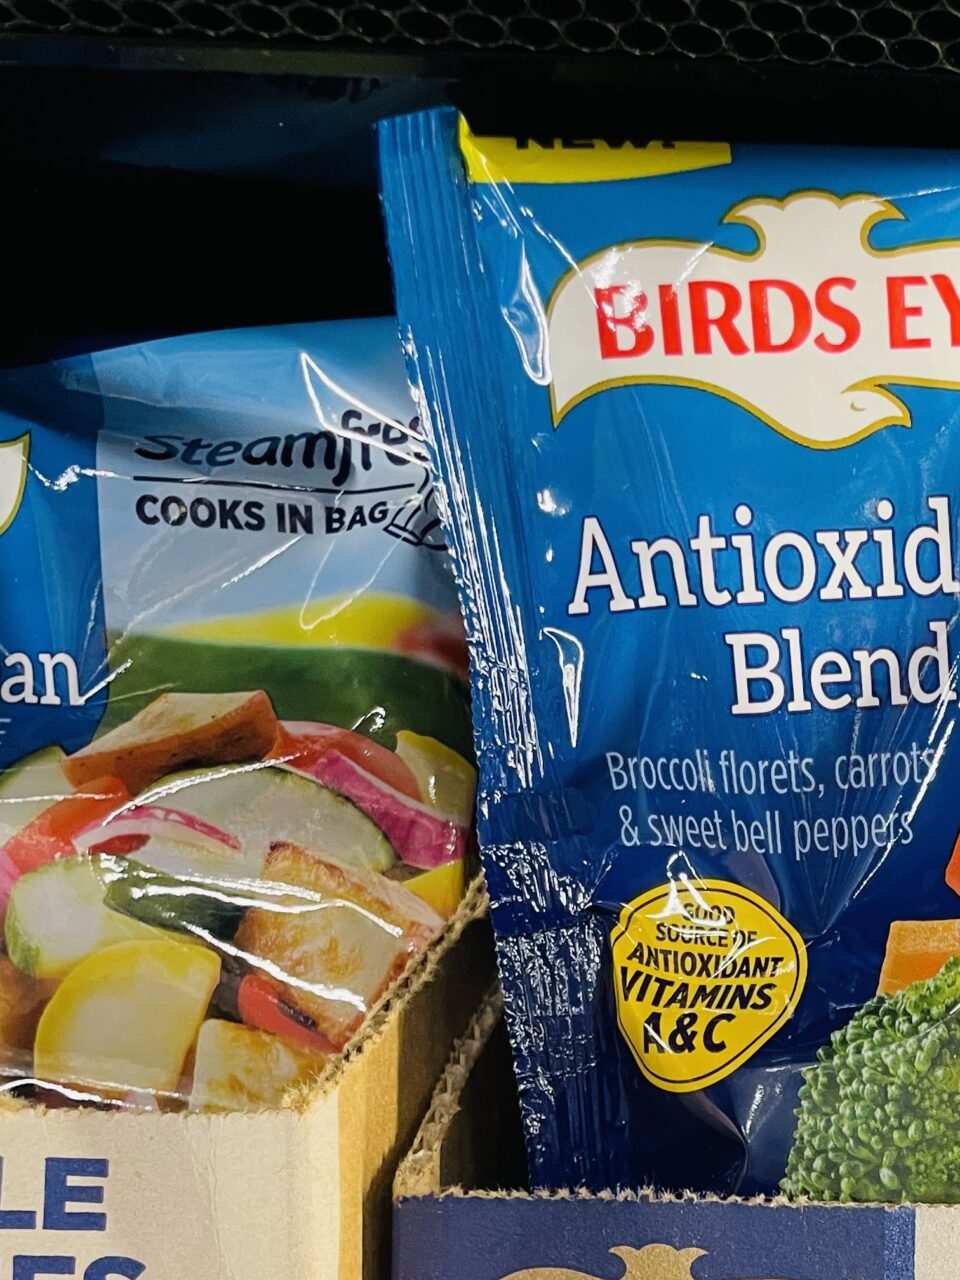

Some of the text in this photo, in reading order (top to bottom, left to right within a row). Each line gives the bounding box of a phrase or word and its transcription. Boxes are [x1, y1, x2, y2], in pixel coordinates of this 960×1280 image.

[594, 276, 862, 360] BIRDS
[135, 494, 388, 535] COOKS IN BAG
[723, 620, 957, 716] Blend
[606, 742, 937, 798] Broccoli florets, carrots
[618, 804, 913, 862] & sweet bell peppers
[626, 941, 785, 979] ANTIOXIDANT
[655, 922, 730, 948] SOURCE
[620, 966, 777, 1011] VITAMINS
